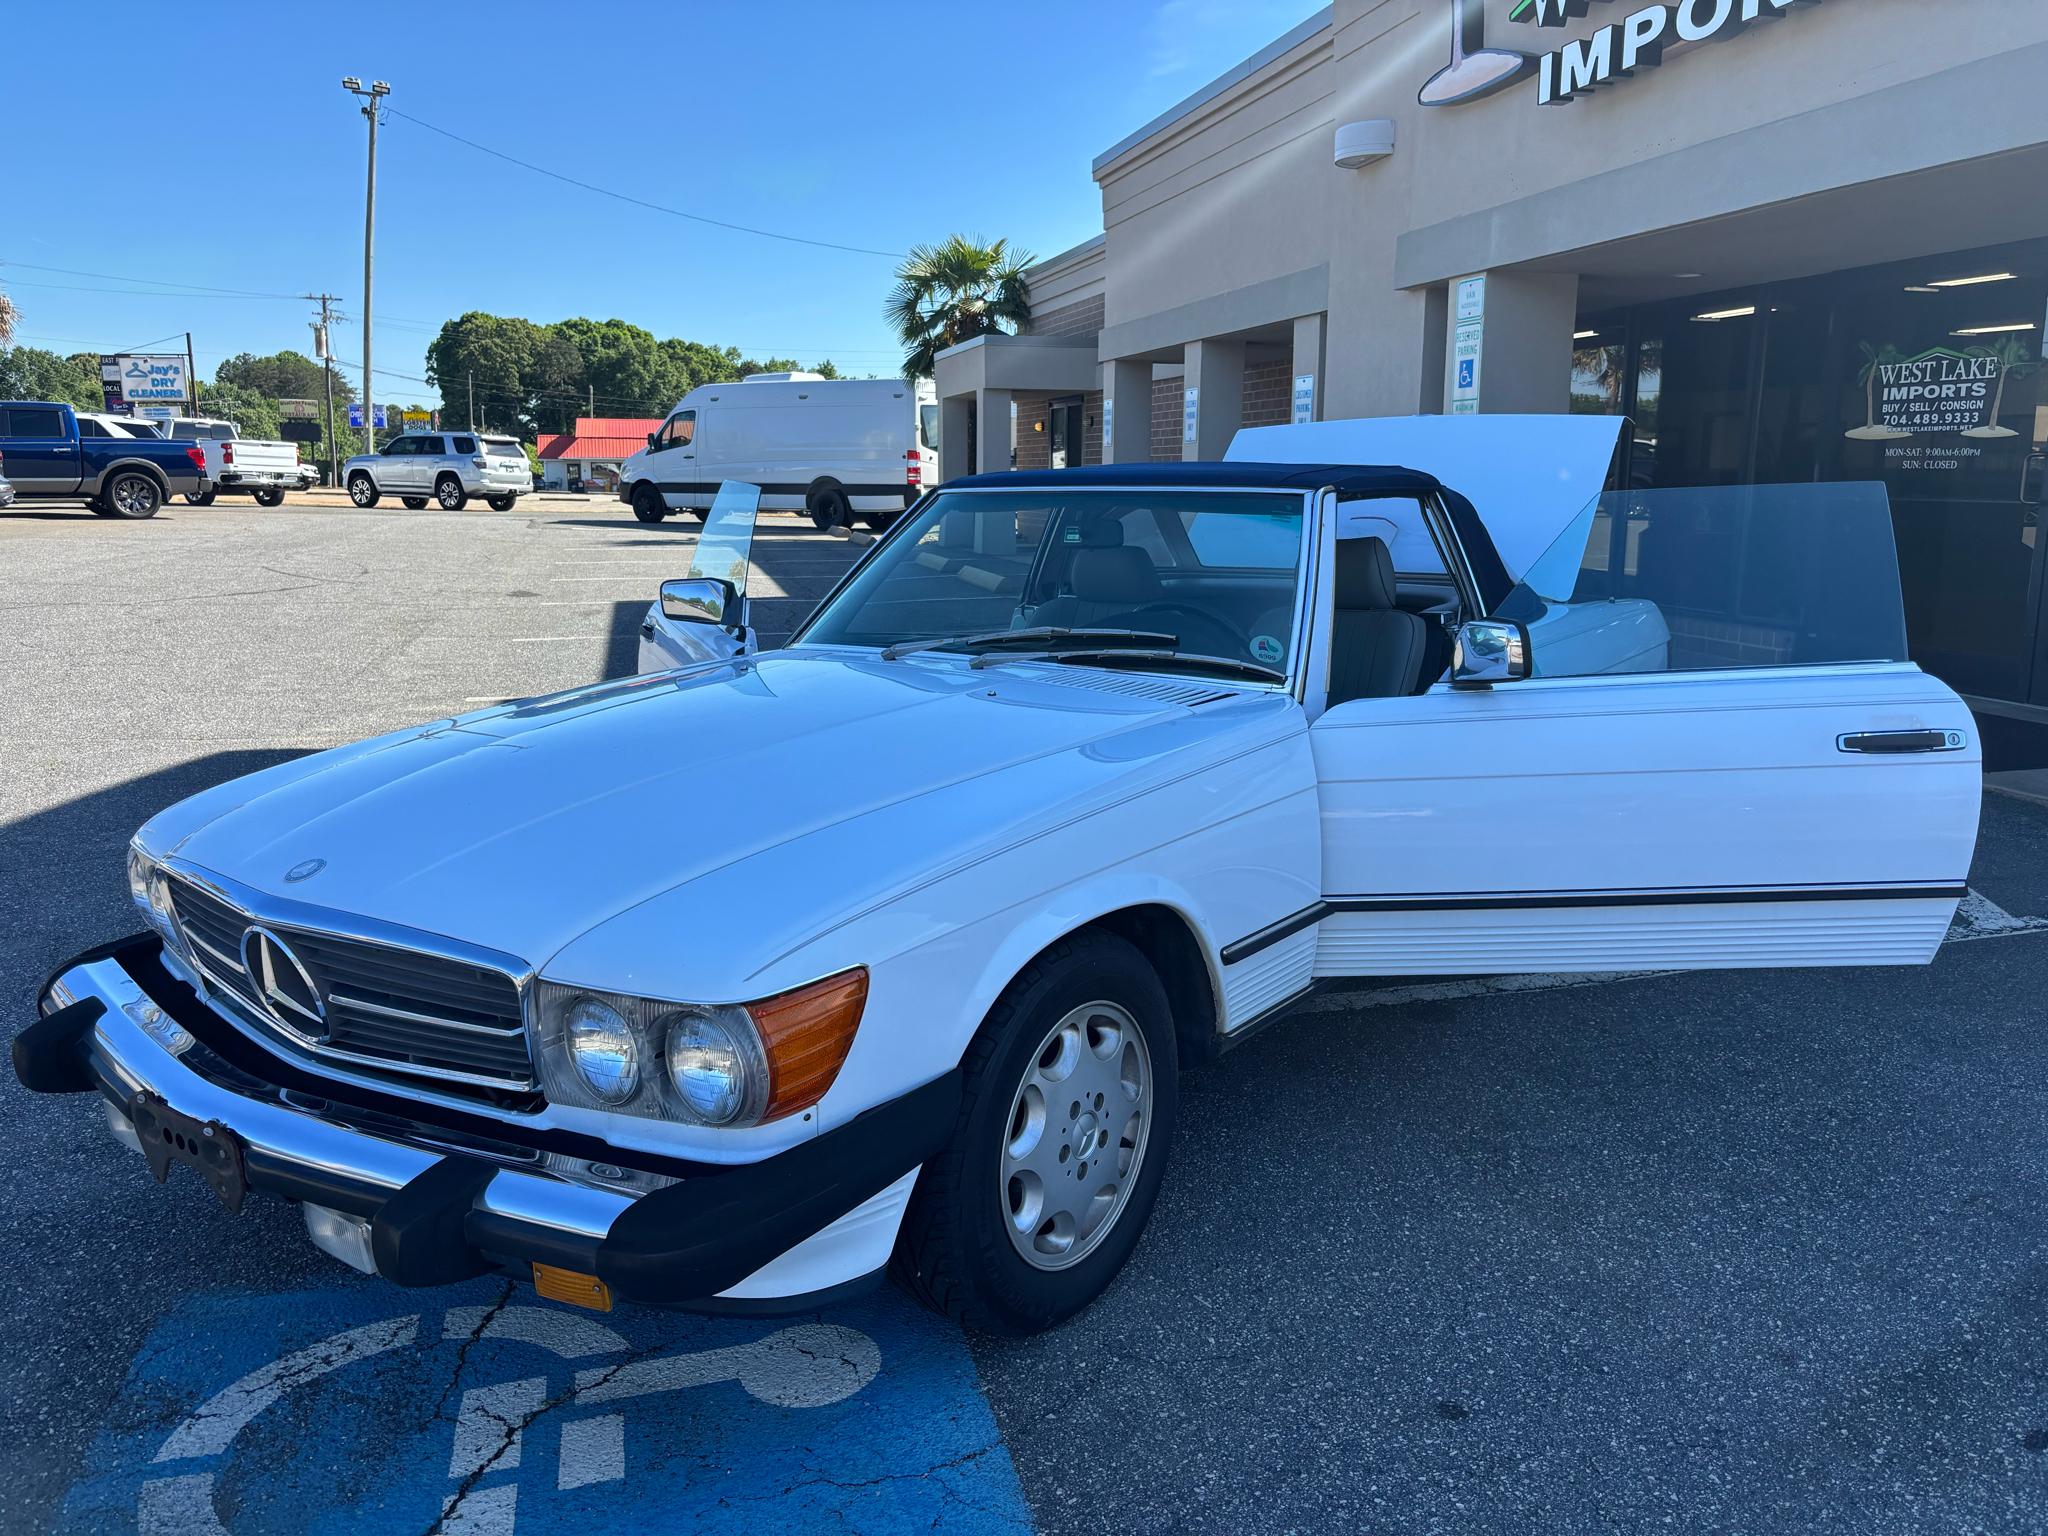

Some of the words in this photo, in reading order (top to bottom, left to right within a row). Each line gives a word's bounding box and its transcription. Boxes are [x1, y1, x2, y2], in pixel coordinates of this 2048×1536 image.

[1456, 330, 1480, 343] RESERVED
[1457, 344, 1478, 357] PARKING
[147, 364, 180, 376] Jay's
[1879, 361, 1936, 385] WEST
[1939, 356, 1997, 381] LAKE
[151, 378, 176, 388] DRY
[128, 389, 184, 398] CLEANERS
[1882, 382, 1987, 401] IMPORTS
[1882, 404, 1900, 413] BUY
[1909, 402, 1930, 412] SELL
[1940, 400, 1984, 411] CONSIGN
[1883, 412, 1980, 426] 704.489.9333
[1925, 447, 1981, 457] 9:00AM-6:00PM
[1902, 460, 1921, 469] SUN:
[1924, 460, 1958, 470] CLOSED
